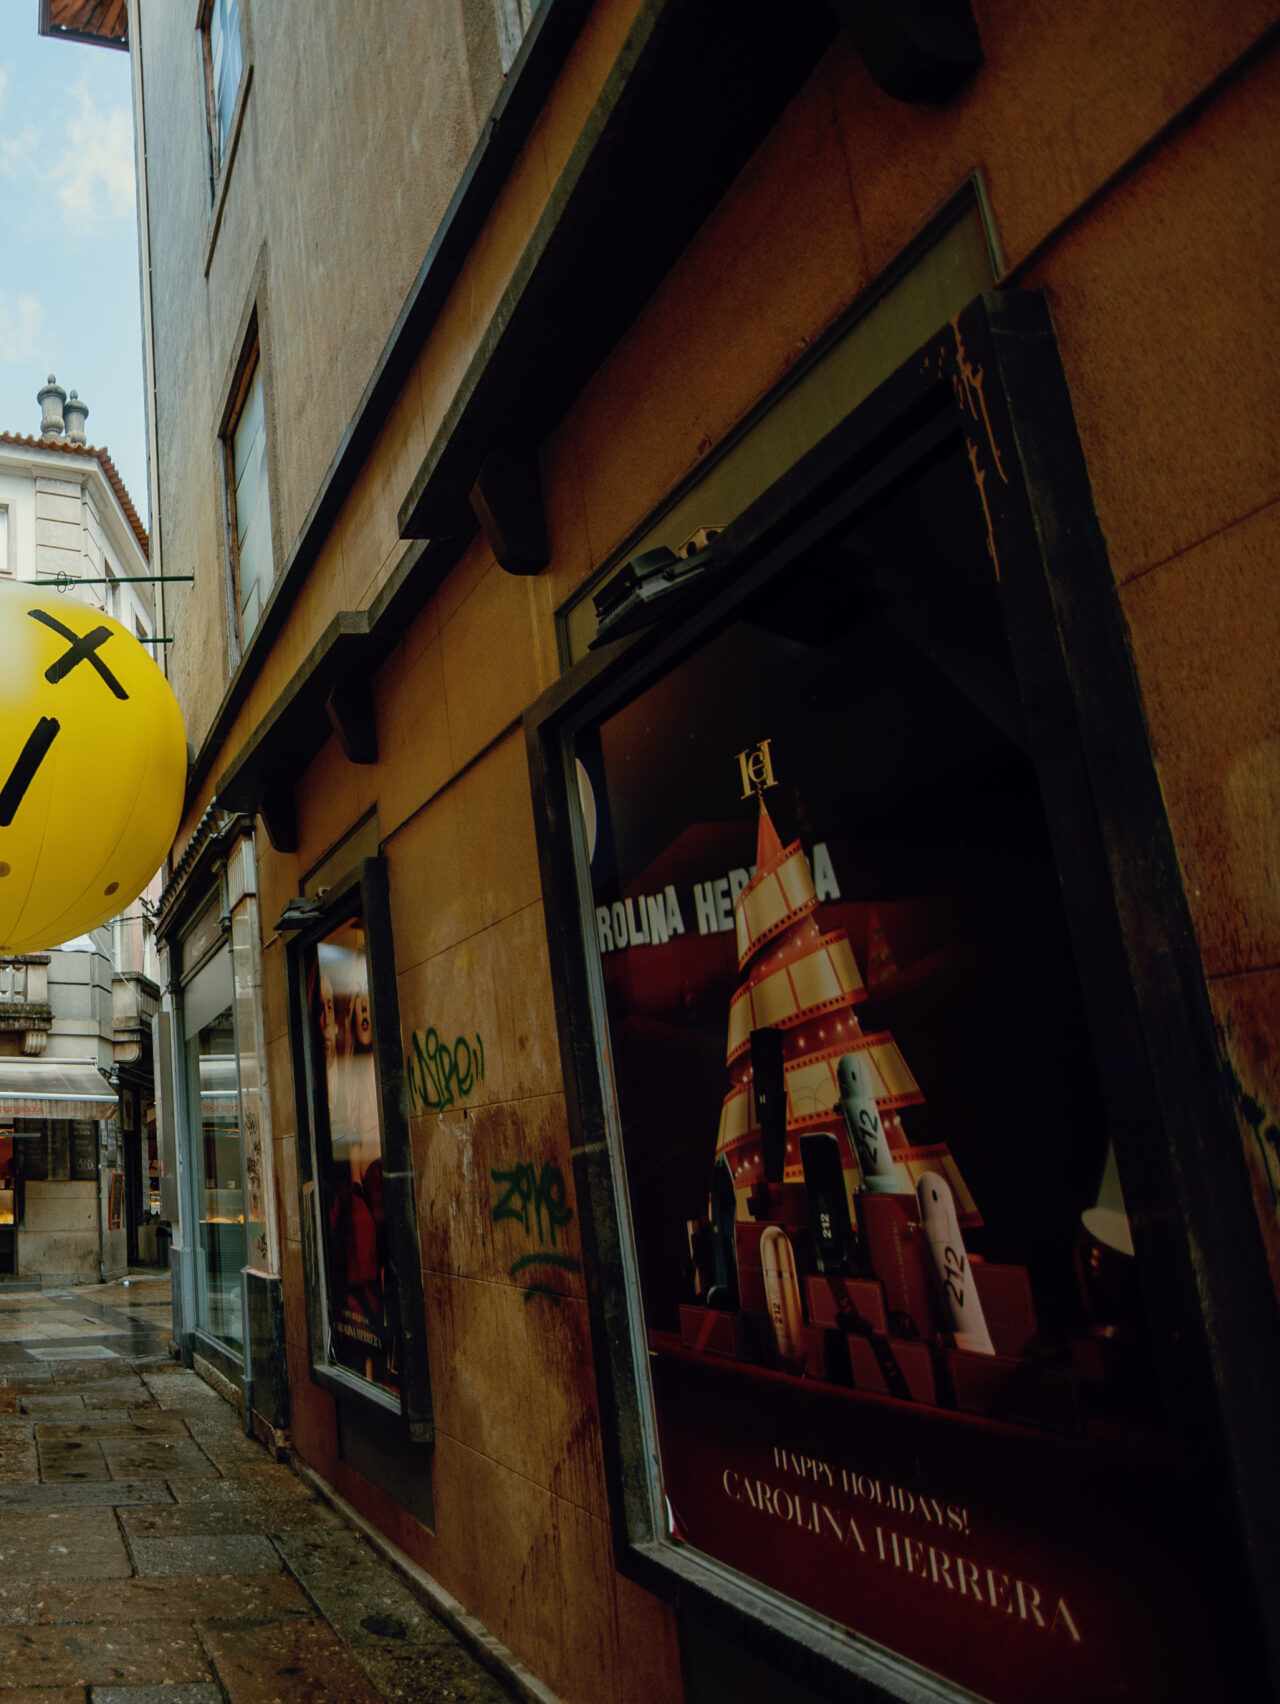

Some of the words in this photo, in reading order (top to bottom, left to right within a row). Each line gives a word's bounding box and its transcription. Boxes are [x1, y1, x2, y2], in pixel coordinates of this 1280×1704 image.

[858, 1109, 878, 1165] 212
[820, 1212, 833, 1239] 212
[944, 1246, 965, 1307] 212
[772, 1302, 783, 1324] 212
[773, 1446, 835, 1487] HAPPY
[841, 1468, 970, 1535] HOLIDAYS!
[722, 1467, 866, 1552] CAROLINA
[875, 1525, 1082, 1643] HERRERA
